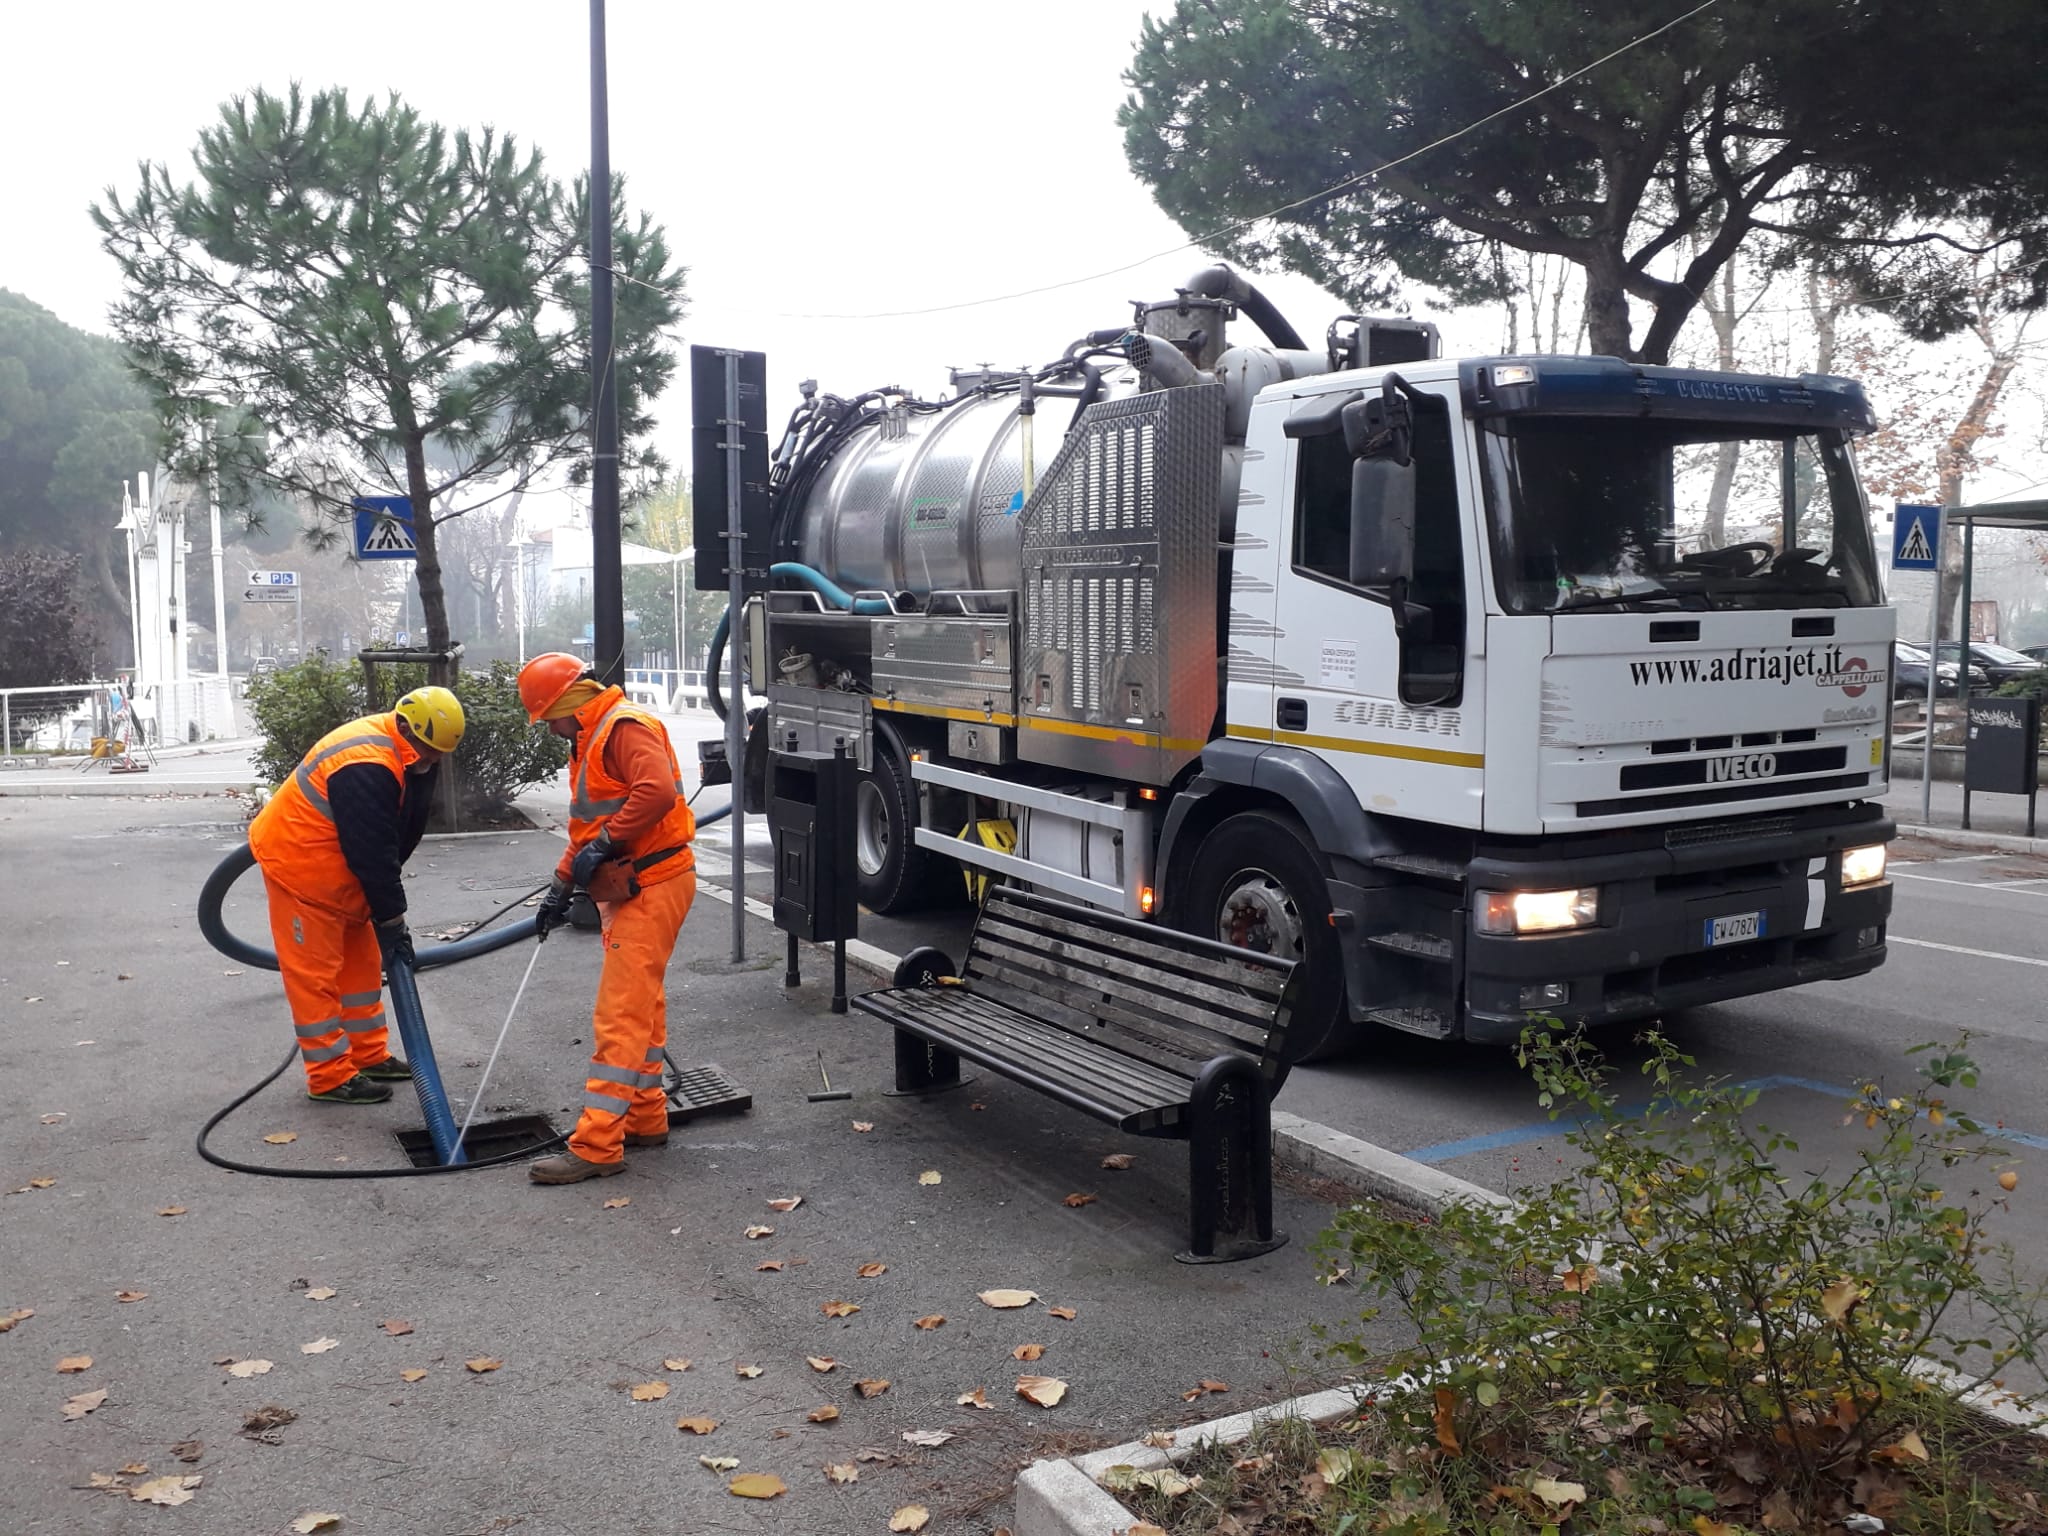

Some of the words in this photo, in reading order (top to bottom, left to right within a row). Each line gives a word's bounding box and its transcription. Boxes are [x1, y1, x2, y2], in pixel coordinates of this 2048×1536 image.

[1630, 643, 1842, 686] www.adriajet.it
[1334, 701, 1462, 736] CURSOR
[1706, 753, 1777, 782] IVECO
